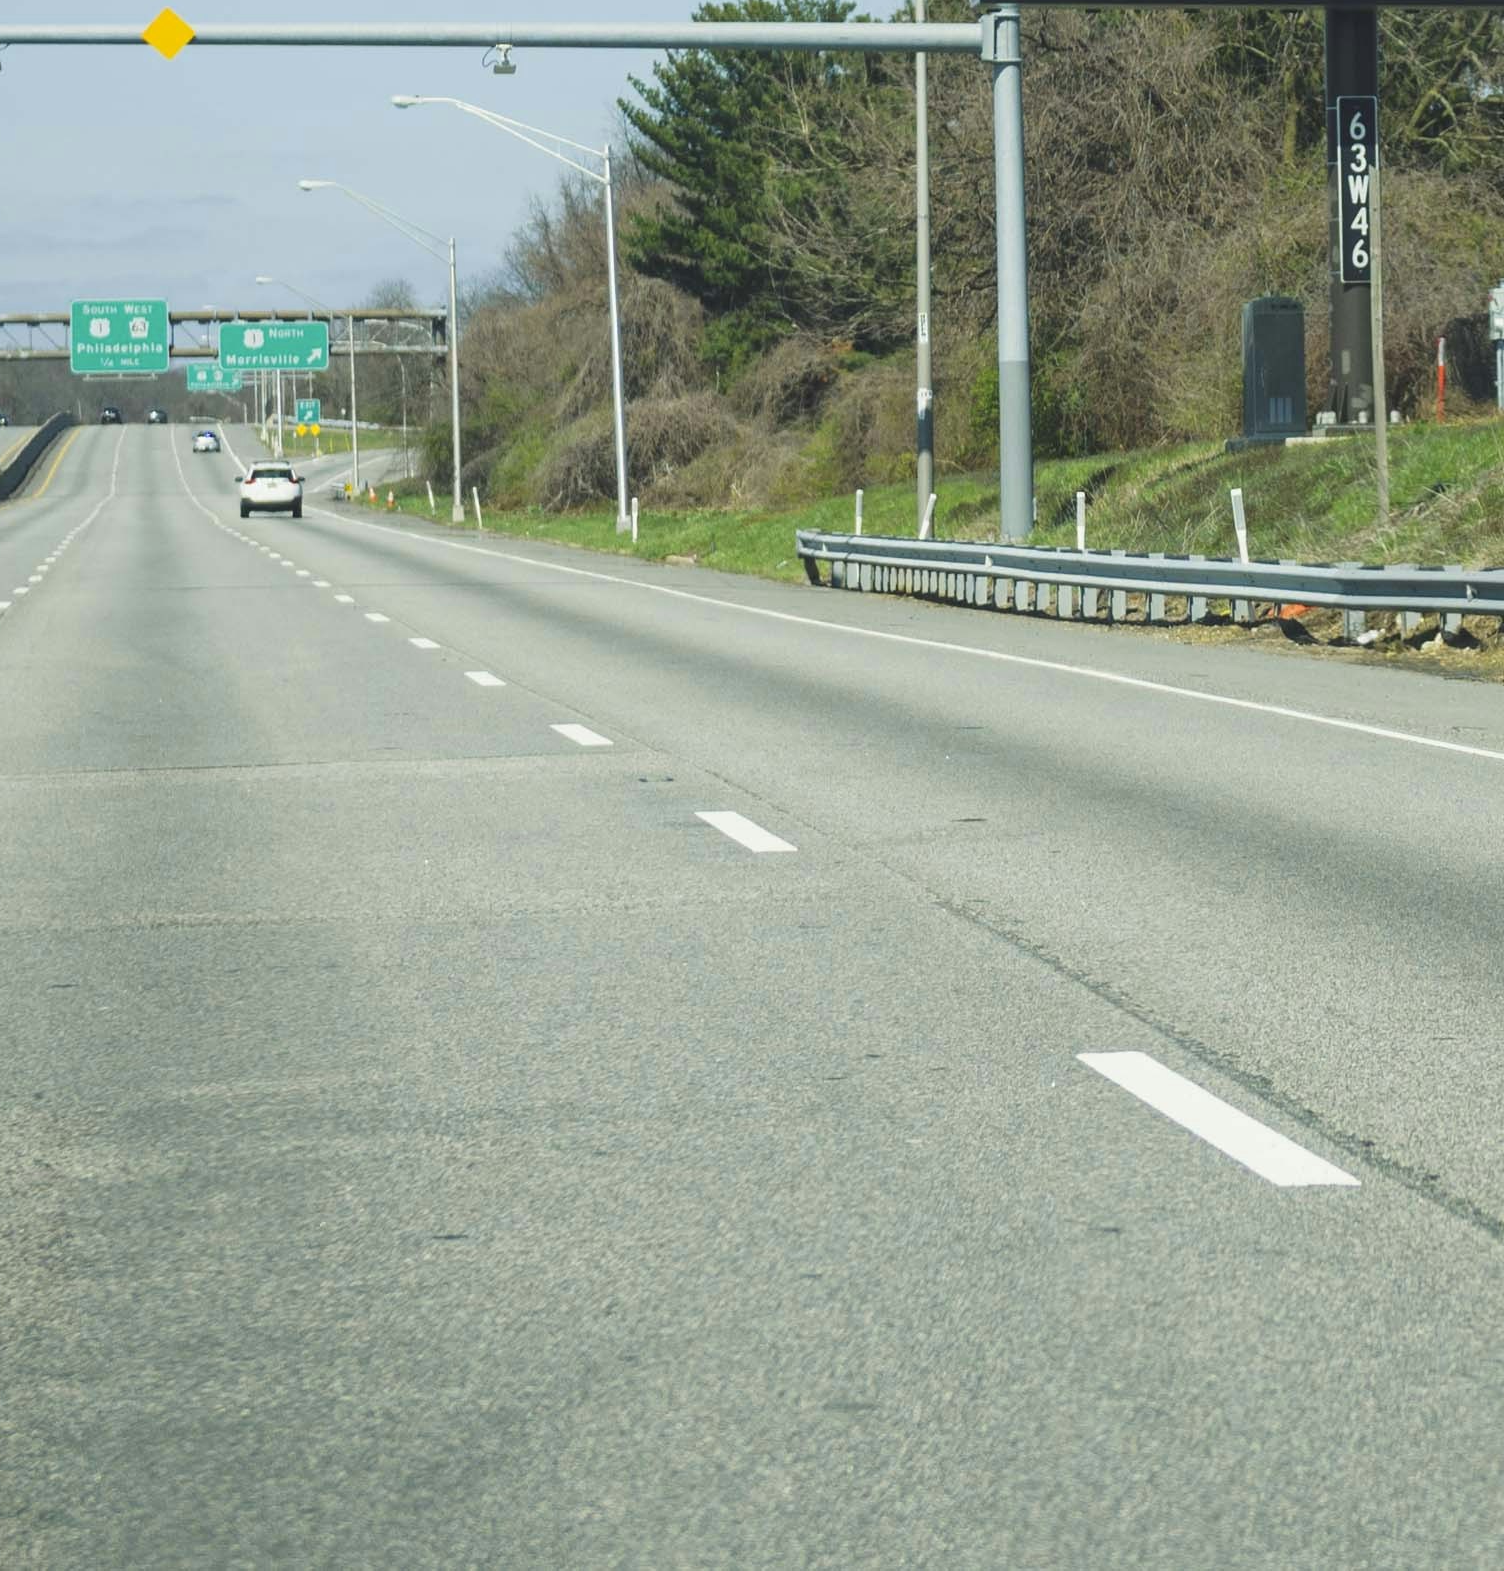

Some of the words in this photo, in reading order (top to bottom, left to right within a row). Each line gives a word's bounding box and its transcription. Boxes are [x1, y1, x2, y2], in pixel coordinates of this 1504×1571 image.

[1347, 111, 1369, 269] 63W46
[83, 304, 117, 314] SOUTH
[124, 304, 152, 314] WEST
[269, 328, 304, 338] NORTH
[77, 342, 163, 354] Philadelphia
[226, 354, 300, 365] Morrisville
